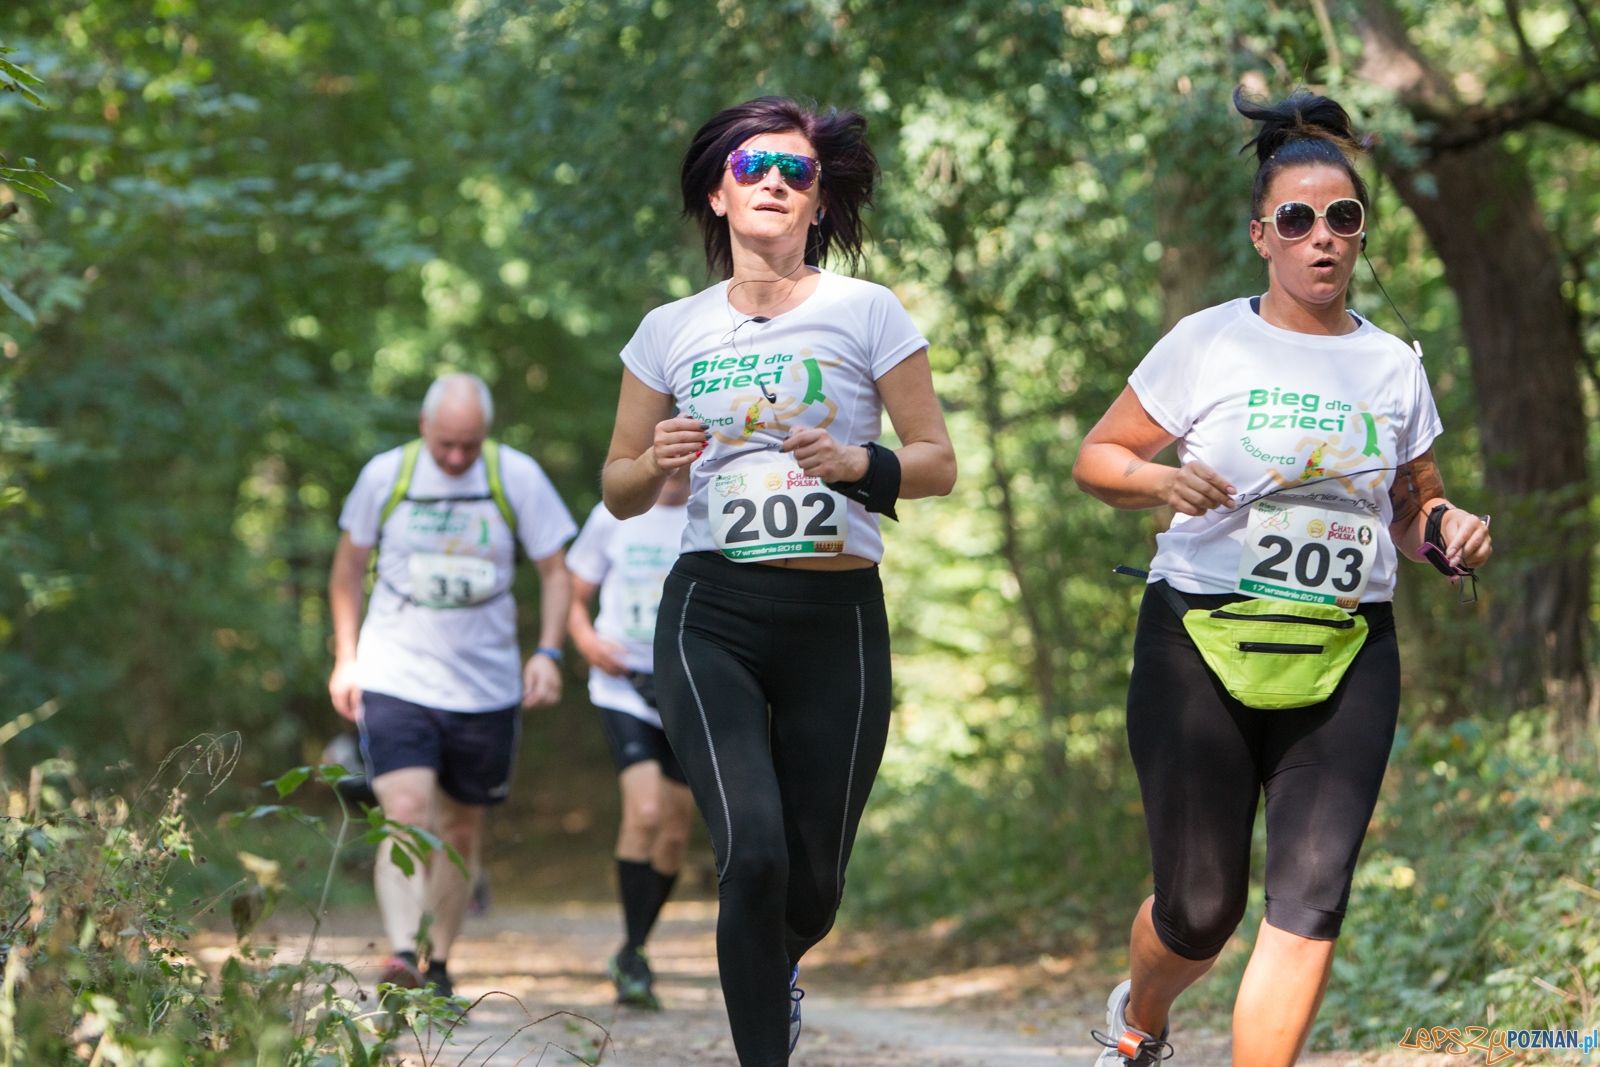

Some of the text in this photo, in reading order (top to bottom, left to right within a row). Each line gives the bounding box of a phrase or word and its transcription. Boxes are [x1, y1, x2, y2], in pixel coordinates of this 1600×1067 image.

[691, 353, 793, 379] Bieg dla
[691, 365, 784, 399] Dzieci
[1248, 387, 1352, 413] Bieg dla
[1246, 409, 1345, 432] Dzieci
[1240, 436, 1296, 465] Roberta
[786, 480, 820, 490] POLSKA
[722, 492, 838, 544] 202
[1331, 522, 1355, 534] CHATA
[777, 544, 803, 552] 2016
[1327, 531, 1356, 541] POLSKA
[1251, 534, 1364, 593] 203
